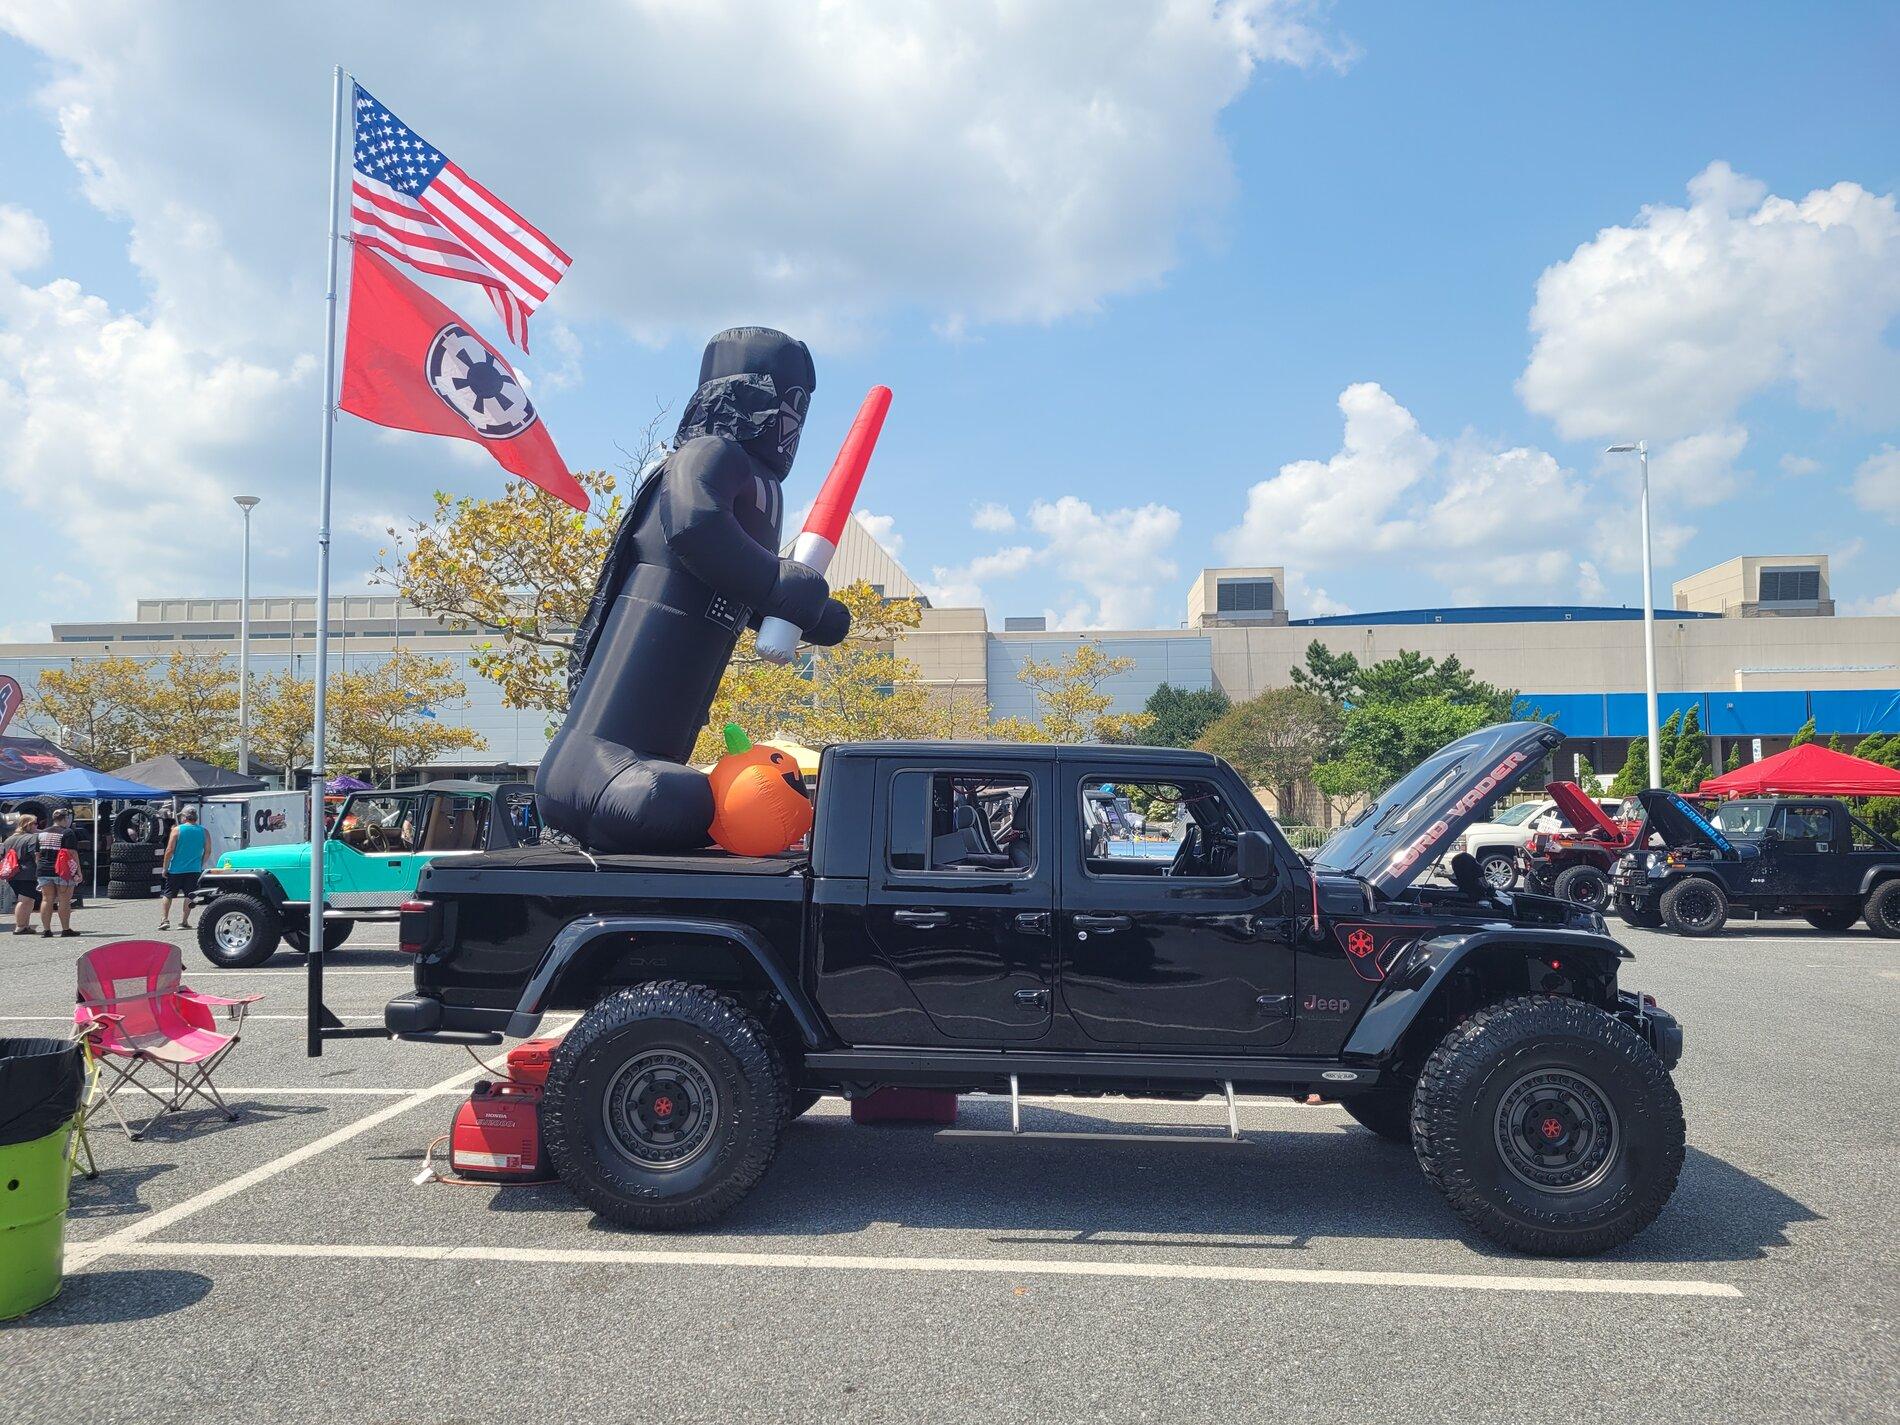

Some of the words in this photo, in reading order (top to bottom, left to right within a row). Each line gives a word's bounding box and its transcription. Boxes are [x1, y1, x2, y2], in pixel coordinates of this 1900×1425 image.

[1386, 820, 1449, 878] LORD
[1447, 751, 1528, 817] VADER
[1675, 801, 1731, 852] SCRAMBLER
[1303, 995, 1350, 1014] Jeep
